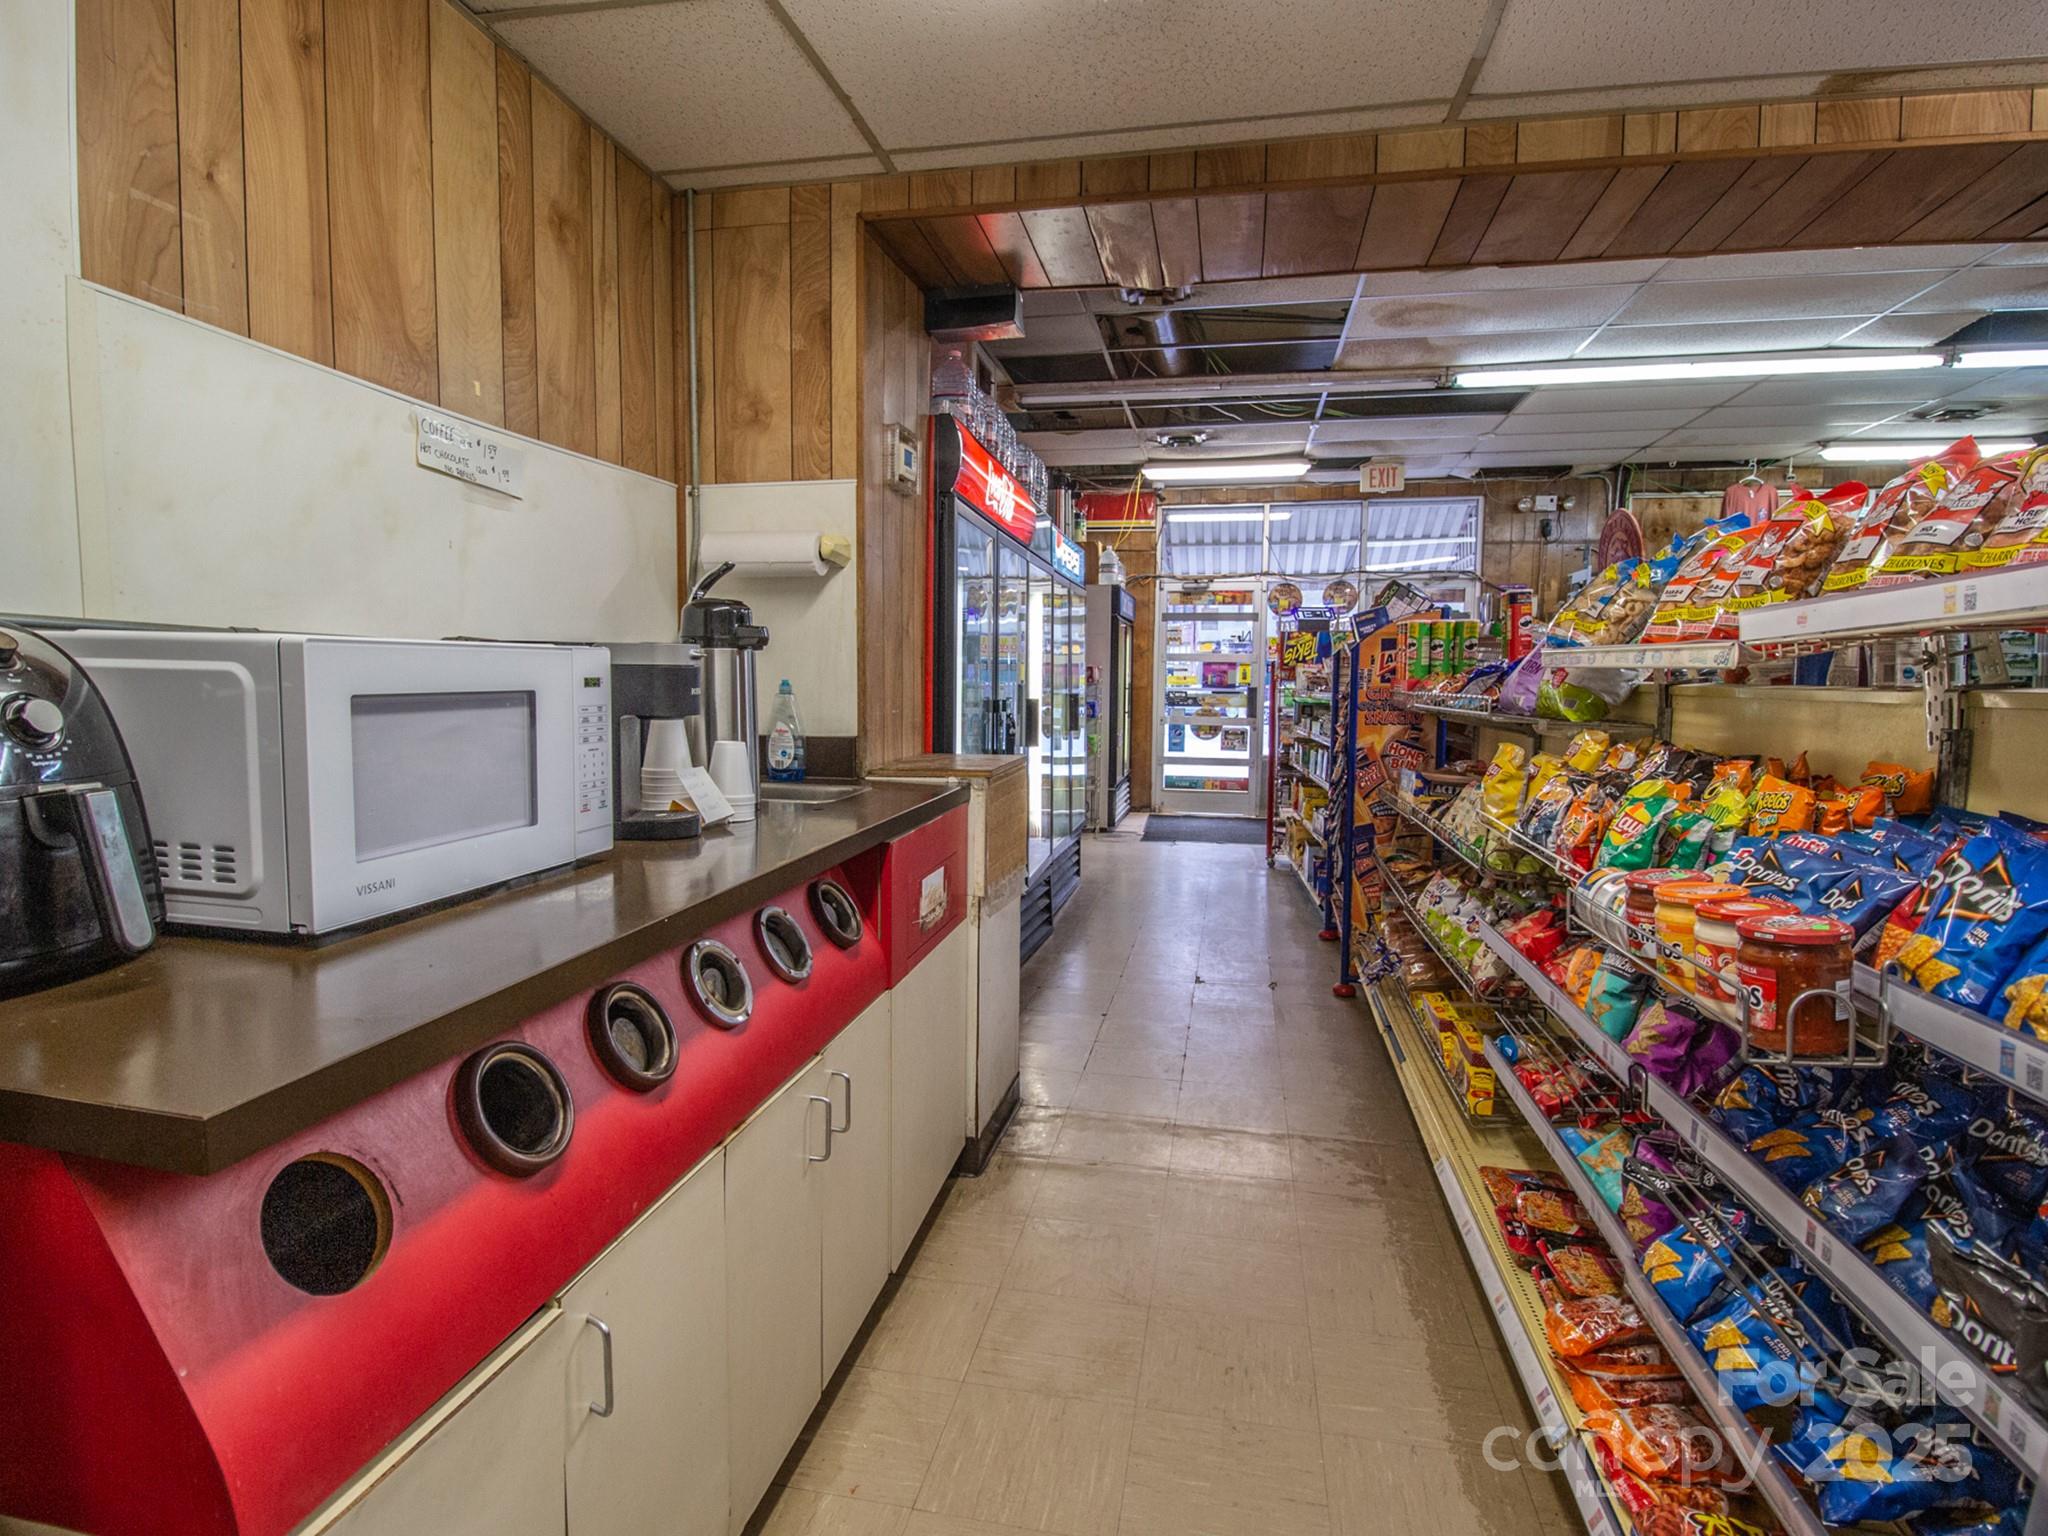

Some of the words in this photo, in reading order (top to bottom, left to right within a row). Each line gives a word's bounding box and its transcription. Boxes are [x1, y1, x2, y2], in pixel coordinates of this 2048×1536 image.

[420, 418, 455, 442] COFFEE
[420, 442, 432, 455] HOT
[1369, 466, 1399, 489] EXIT
[1388, 742, 1431, 763] HONEY
[1390, 758, 1418, 771] BUN
[1736, 856, 1801, 893] Doritos
[355, 878, 396, 896] VISSANI
[1763, 1335, 1789, 1362] RANCH
[1773, 1338, 1793, 1358] COOL
